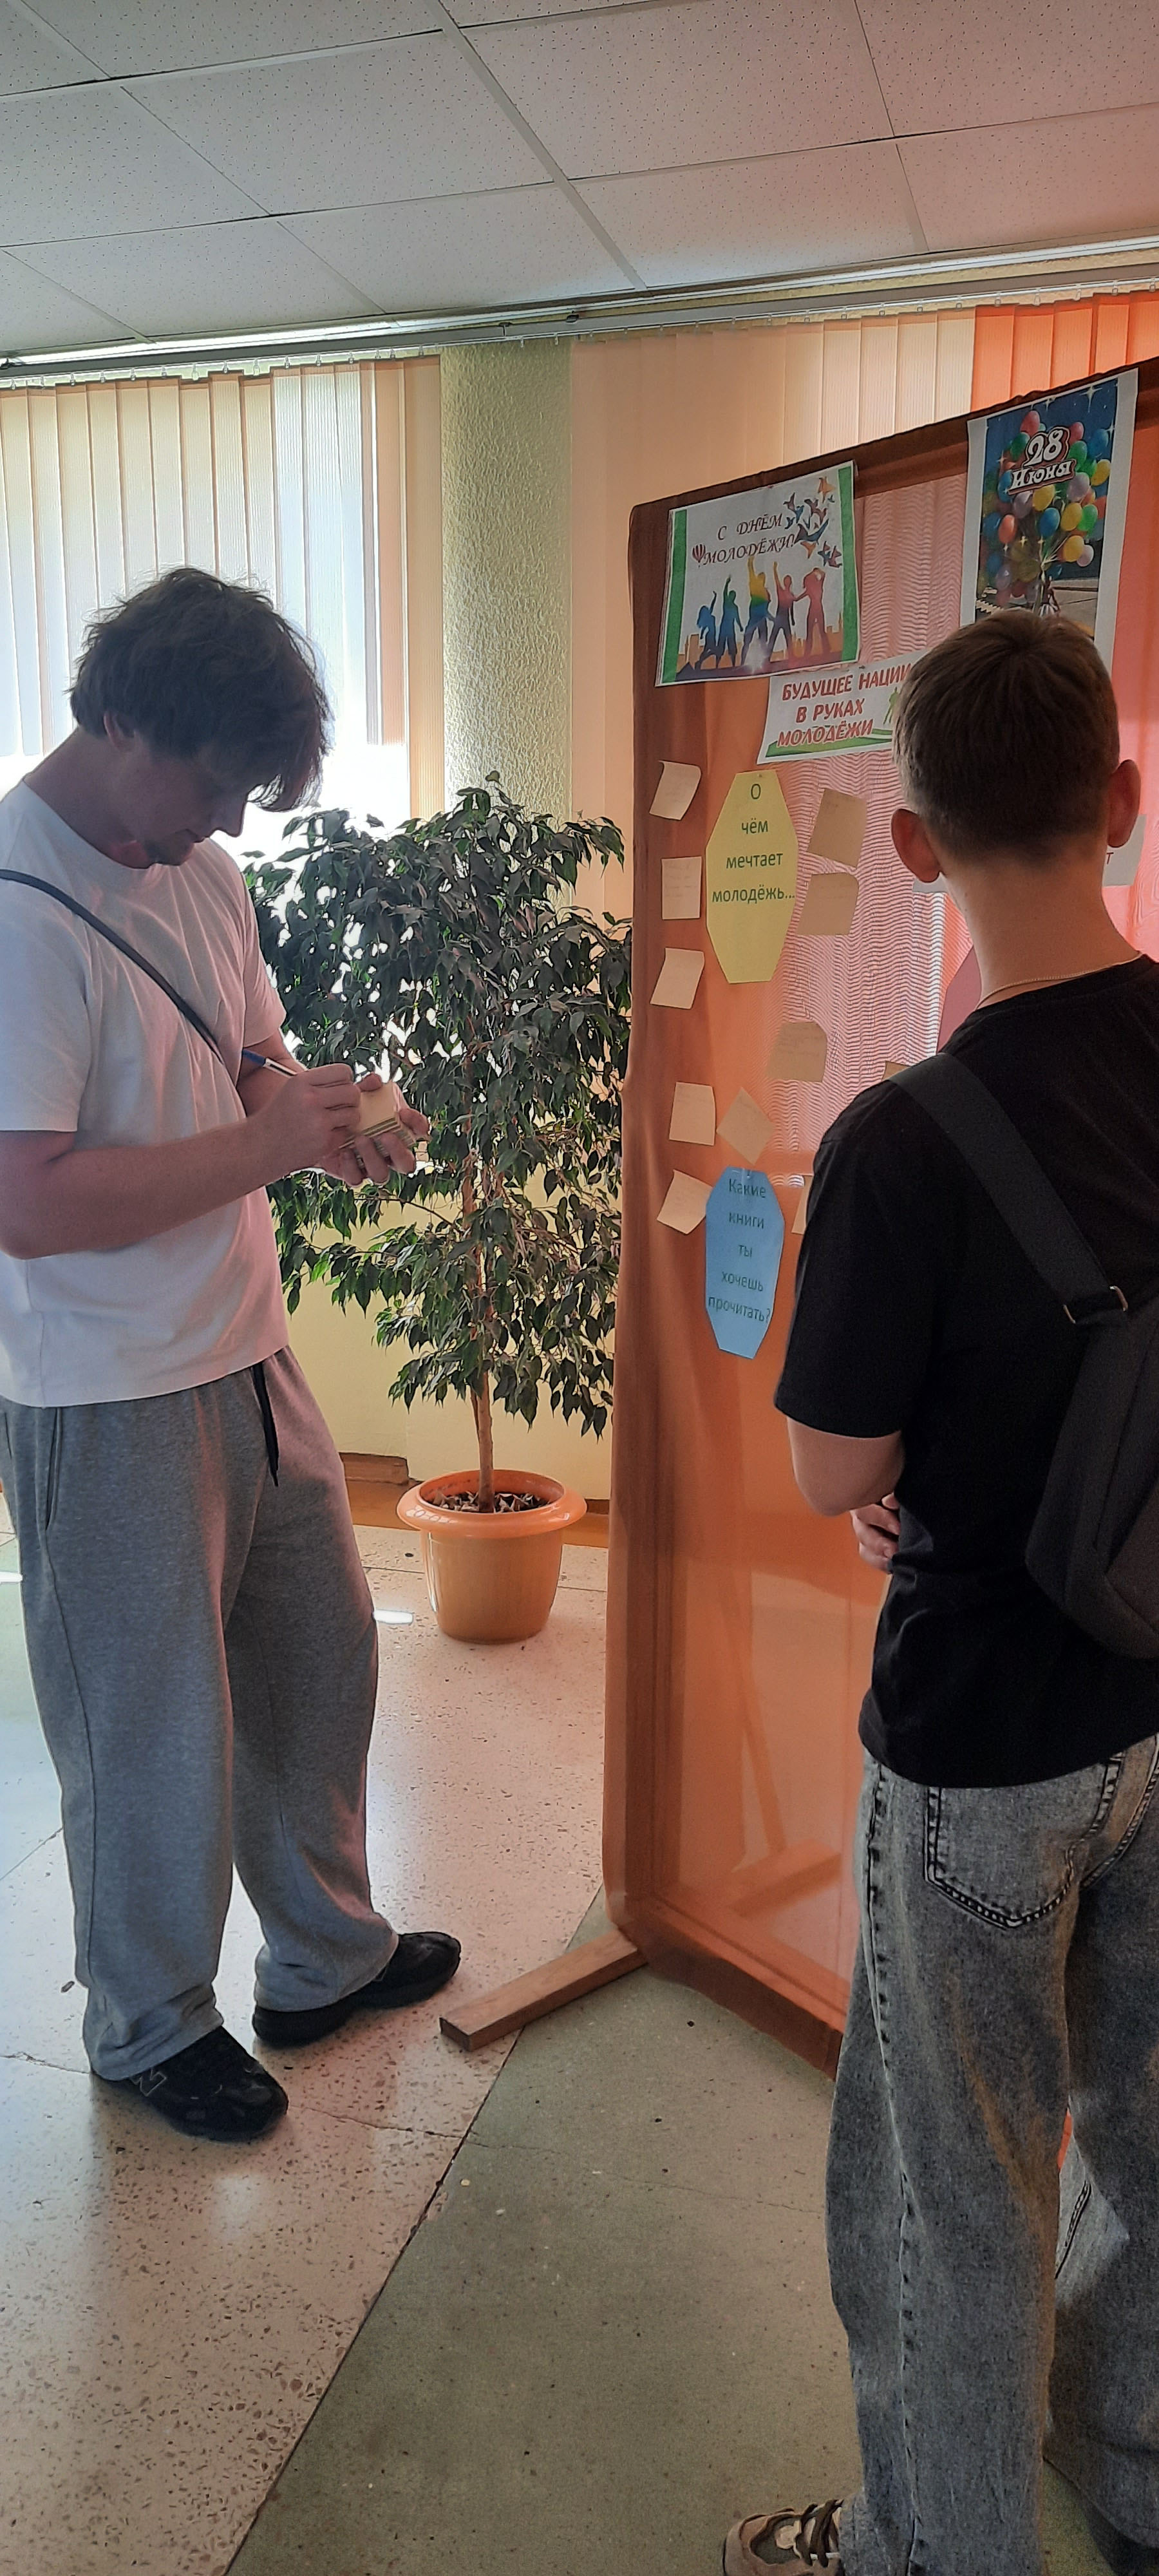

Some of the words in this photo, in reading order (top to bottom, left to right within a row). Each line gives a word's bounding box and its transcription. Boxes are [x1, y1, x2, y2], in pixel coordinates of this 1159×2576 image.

[1024, 429, 1064, 468] 28
[718, 526, 727, 540] С
[737, 513, 782, 535] ДНЁМ
[703, 534, 796, 565] МОЛОДЁЖИ!
[782, 674, 853, 701] БУДУЩЕЕ
[796, 706, 807, 723] В
[813, 698, 865, 721] РУКАХ
[777, 719, 874, 747] МОЛОДЁЖИ
[751, 783, 761, 800] О
[741, 818, 768, 834] чём
[726, 853, 784, 869] мечтает
[712, 884, 796, 904] молодёжь...
[729, 1179, 766, 1198] Какие
[729, 1212, 764, 1229] книги
[739, 1244, 753, 1258] ты
[721, 1271, 764, 1292] хочешь
[708, 1296, 771, 1323] прочитать?
